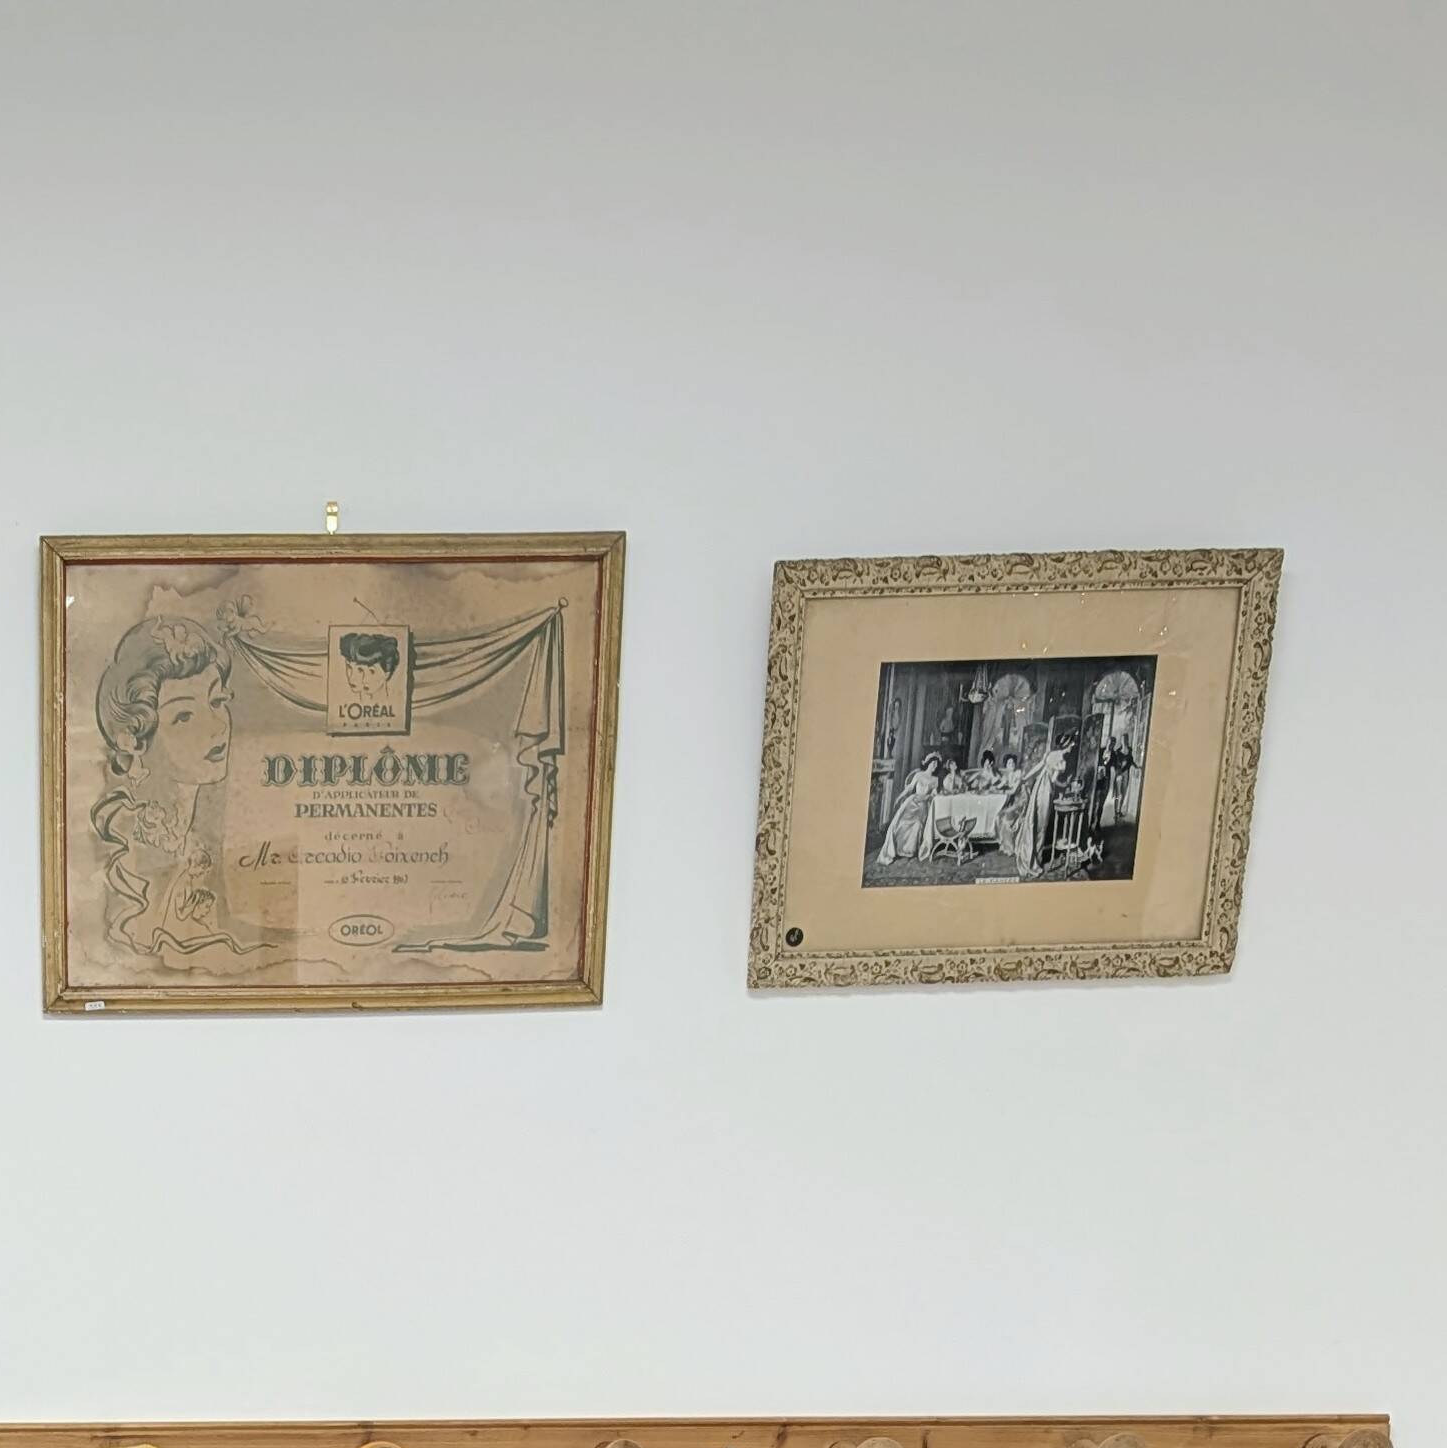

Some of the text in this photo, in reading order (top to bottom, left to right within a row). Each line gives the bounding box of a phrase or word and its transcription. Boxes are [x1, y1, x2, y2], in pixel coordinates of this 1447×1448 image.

[339, 702, 396, 720] L'ORÉAL
[261, 744, 471, 787] DIPLÔME
[403, 790, 420, 799] DE
[293, 802, 438, 819] PERMANENTES
[339, 923, 383, 937] ORÉOL
